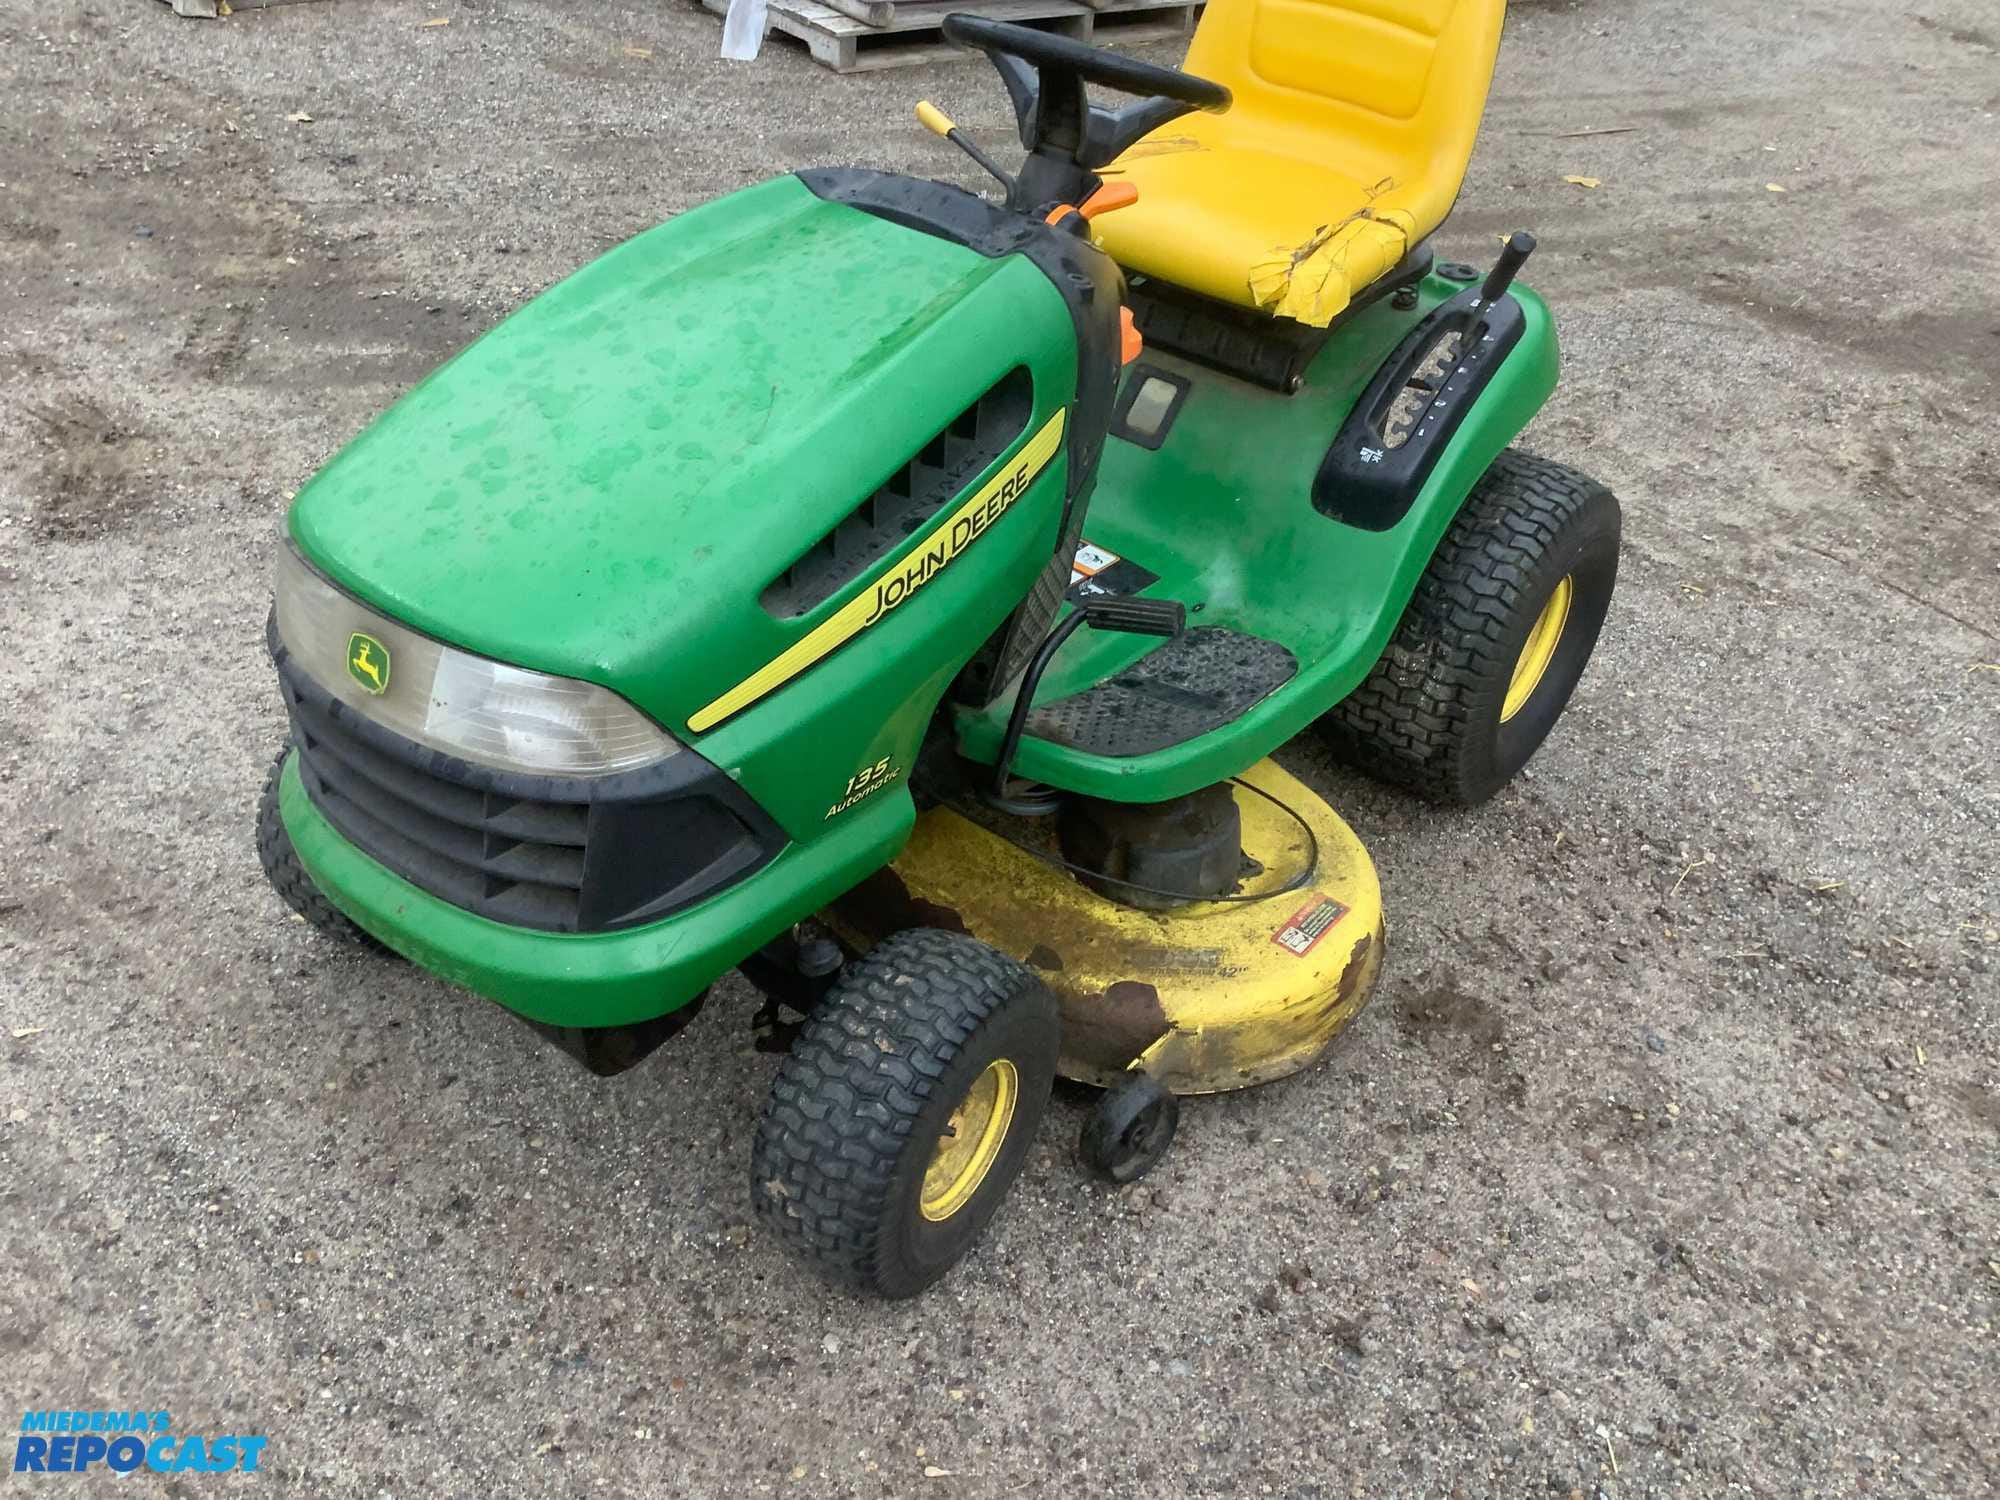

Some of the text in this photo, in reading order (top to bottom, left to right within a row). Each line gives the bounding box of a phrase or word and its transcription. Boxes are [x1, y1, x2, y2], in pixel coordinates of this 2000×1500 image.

[866, 462, 1029, 623] JOHN DEERE
[825, 767, 900, 820] Automatic
[845, 757, 891, 795] 135
